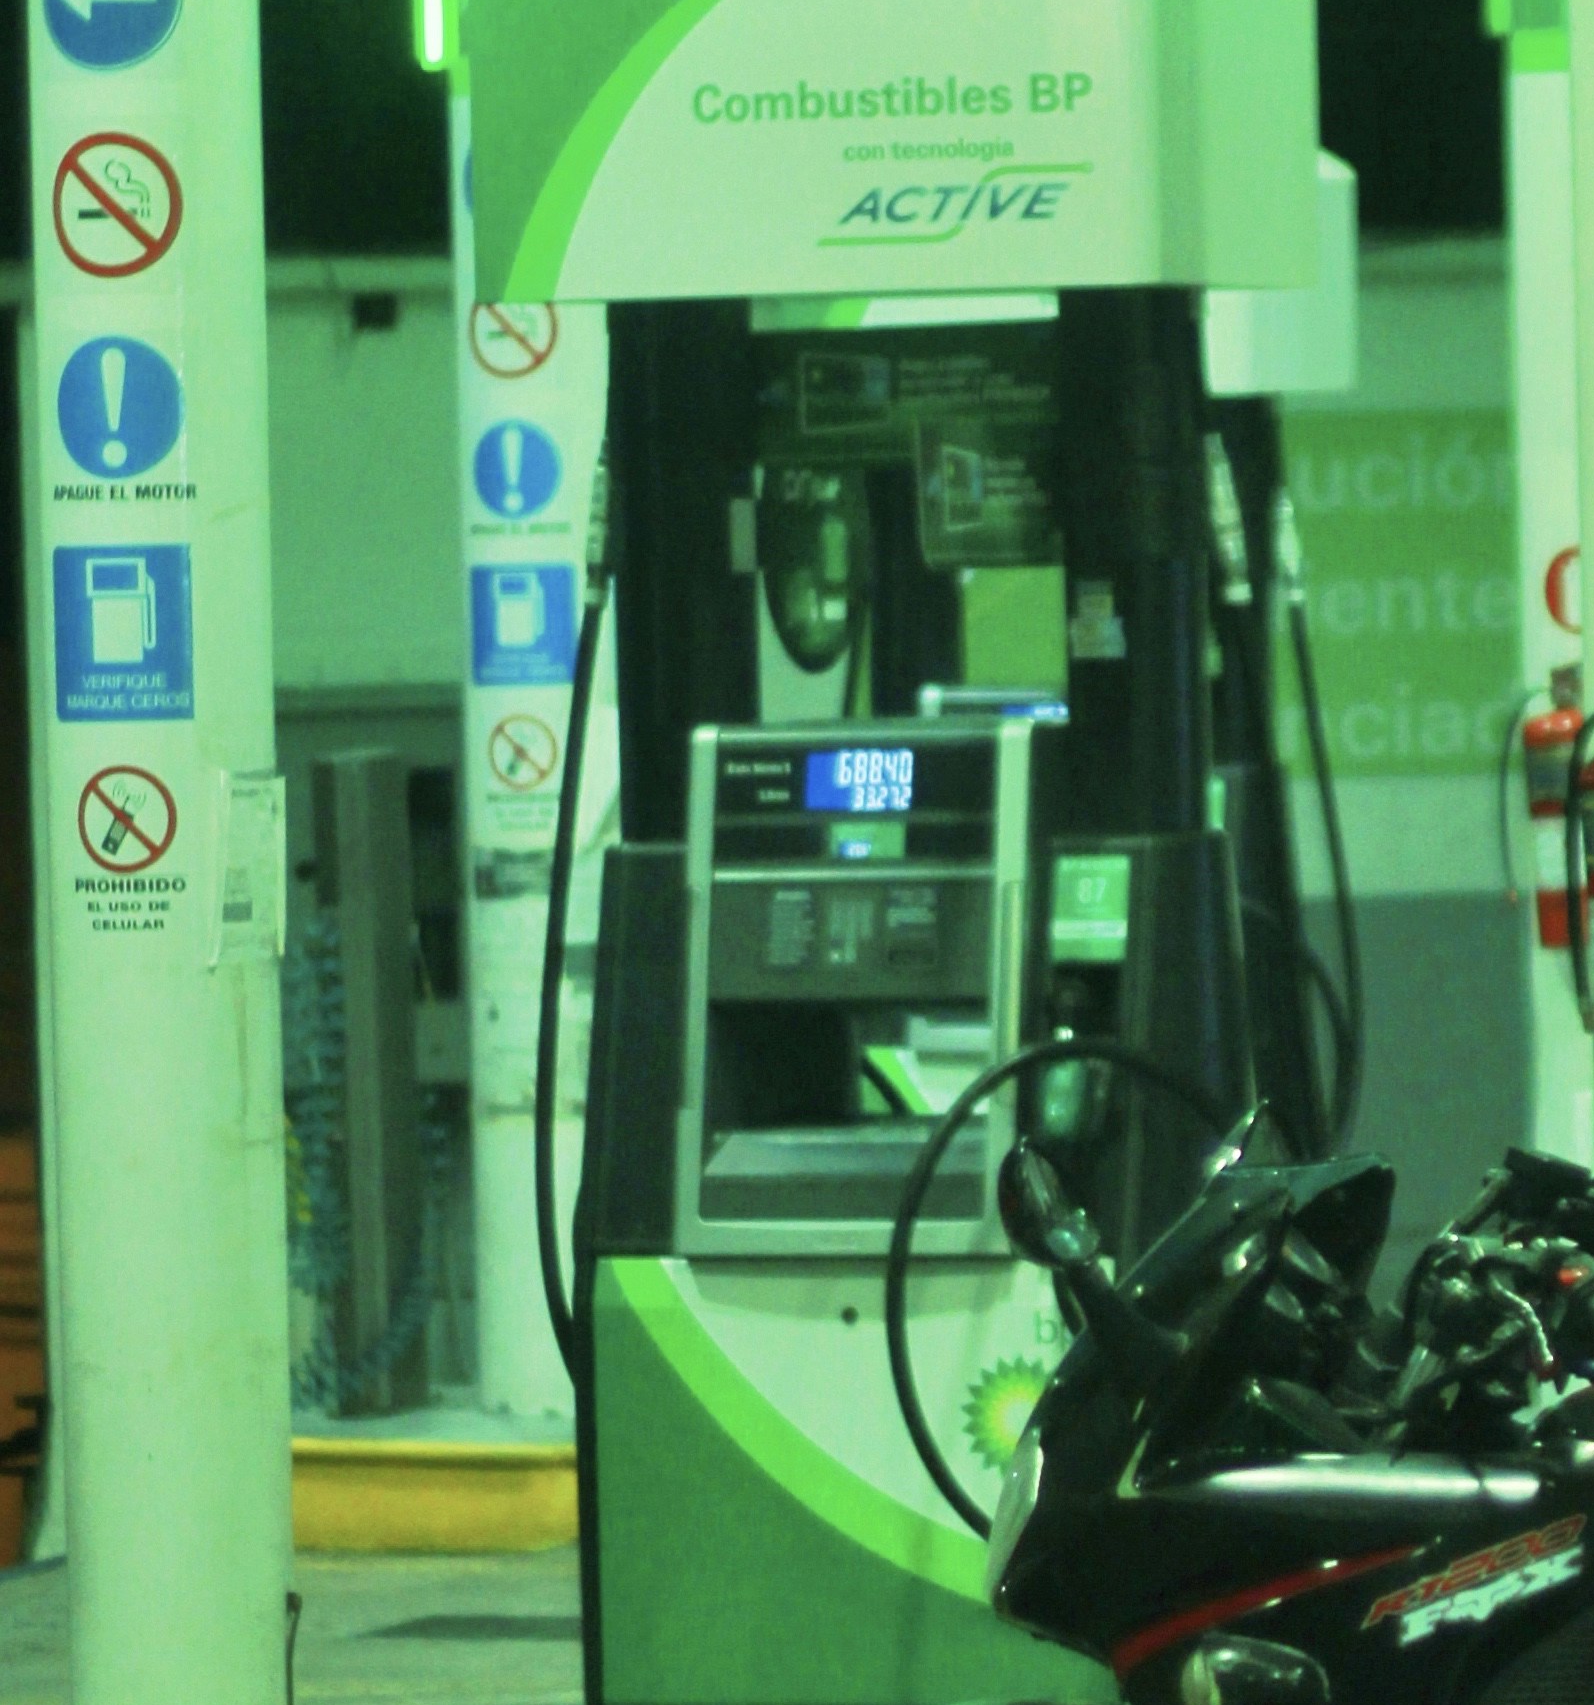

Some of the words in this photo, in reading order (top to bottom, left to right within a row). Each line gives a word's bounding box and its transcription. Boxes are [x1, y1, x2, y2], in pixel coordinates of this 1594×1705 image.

[692, 75, 1013, 124] Combustibles
[1028, 71, 1093, 114] BP
[842, 141, 885, 162] con
[838, 181, 1071, 226] ACTIVE
[53, 484, 104, 501] APAGUE
[110, 484, 130, 501] EL
[135, 482, 197, 500] MOTOR
[81, 673, 167, 690] VERIFIQUE
[130, 692, 191, 709] CEROS
[75, 876, 187, 894] PROHIBIDO
[87, 900, 102, 913] EL
[108, 900, 142, 913] USO
[148, 899, 171, 912] DE
[92, 918, 165, 931] CELULAR
